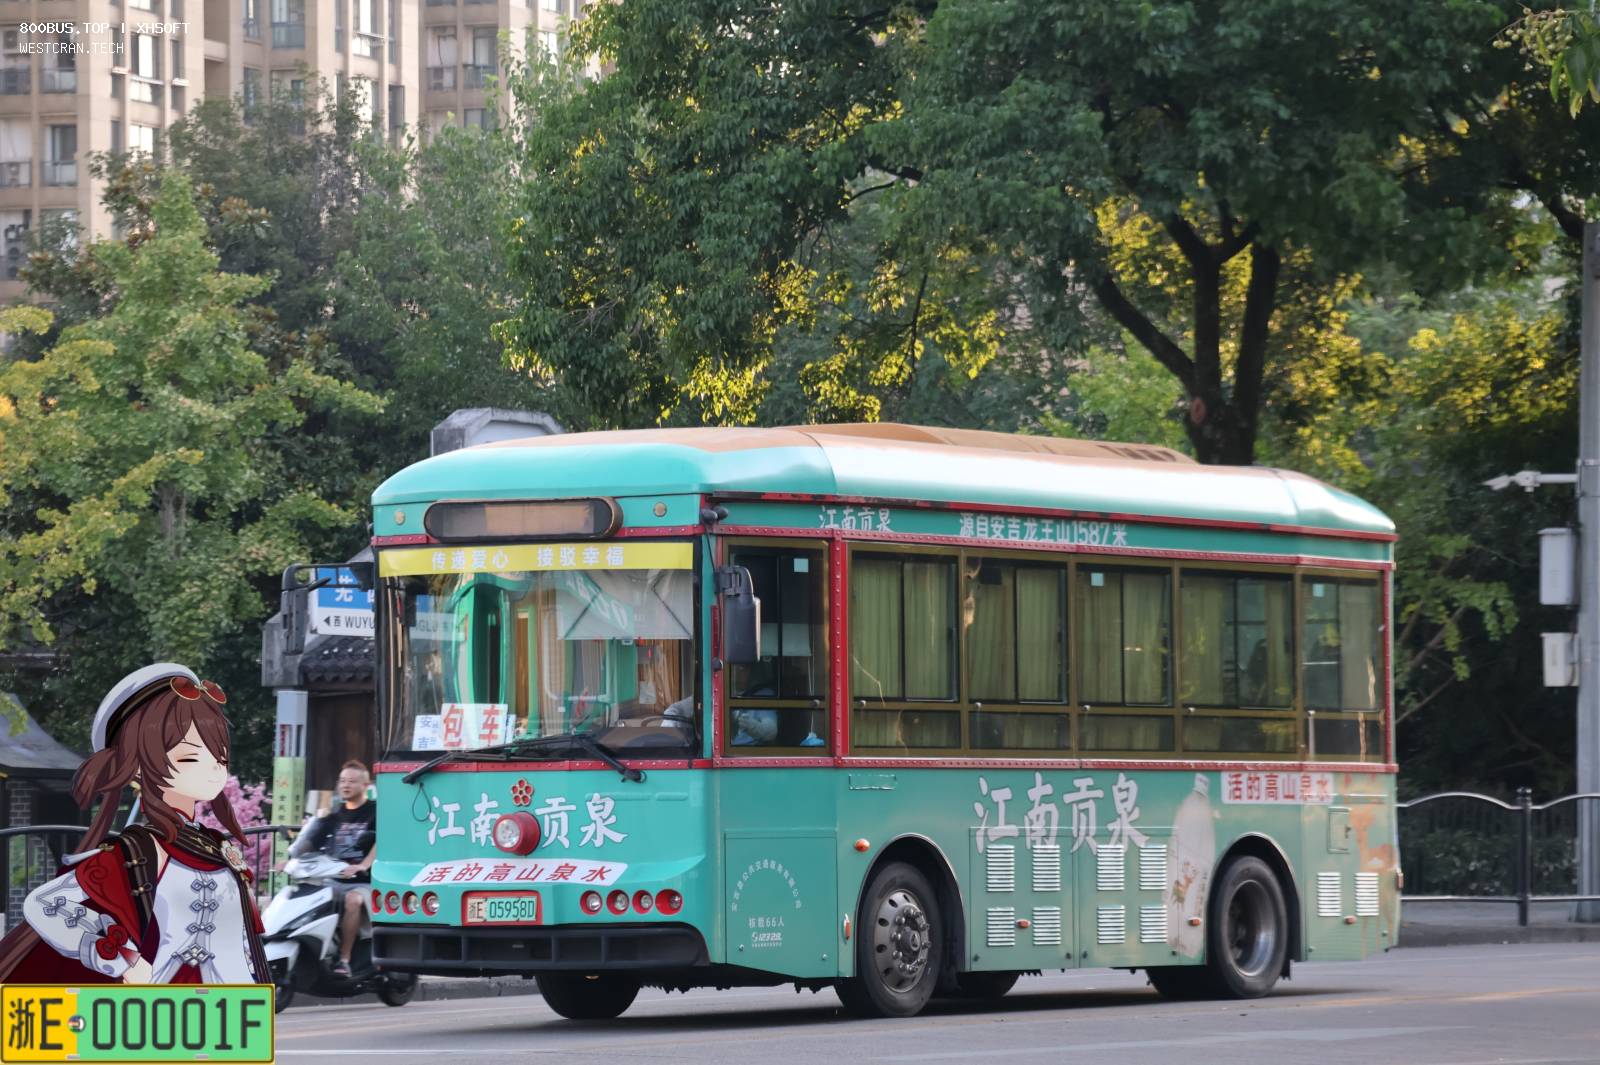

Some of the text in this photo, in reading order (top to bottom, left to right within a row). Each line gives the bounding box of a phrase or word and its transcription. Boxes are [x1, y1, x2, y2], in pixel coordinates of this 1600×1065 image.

[819, 505, 895, 533] 江南贡泉
[959, 512, 1128, 546] 源自安吉龙王山1587米
[538, 546, 624, 567] 接驳幸福
[443, 703, 500, 747] 包车
[1228, 773, 1331, 801] 活的高山泉水
[428, 792, 628, 849] 江南贡泉
[974, 771, 1150, 856] 江南贡泉
[422, 862, 613, 883] 活的高山泉水
